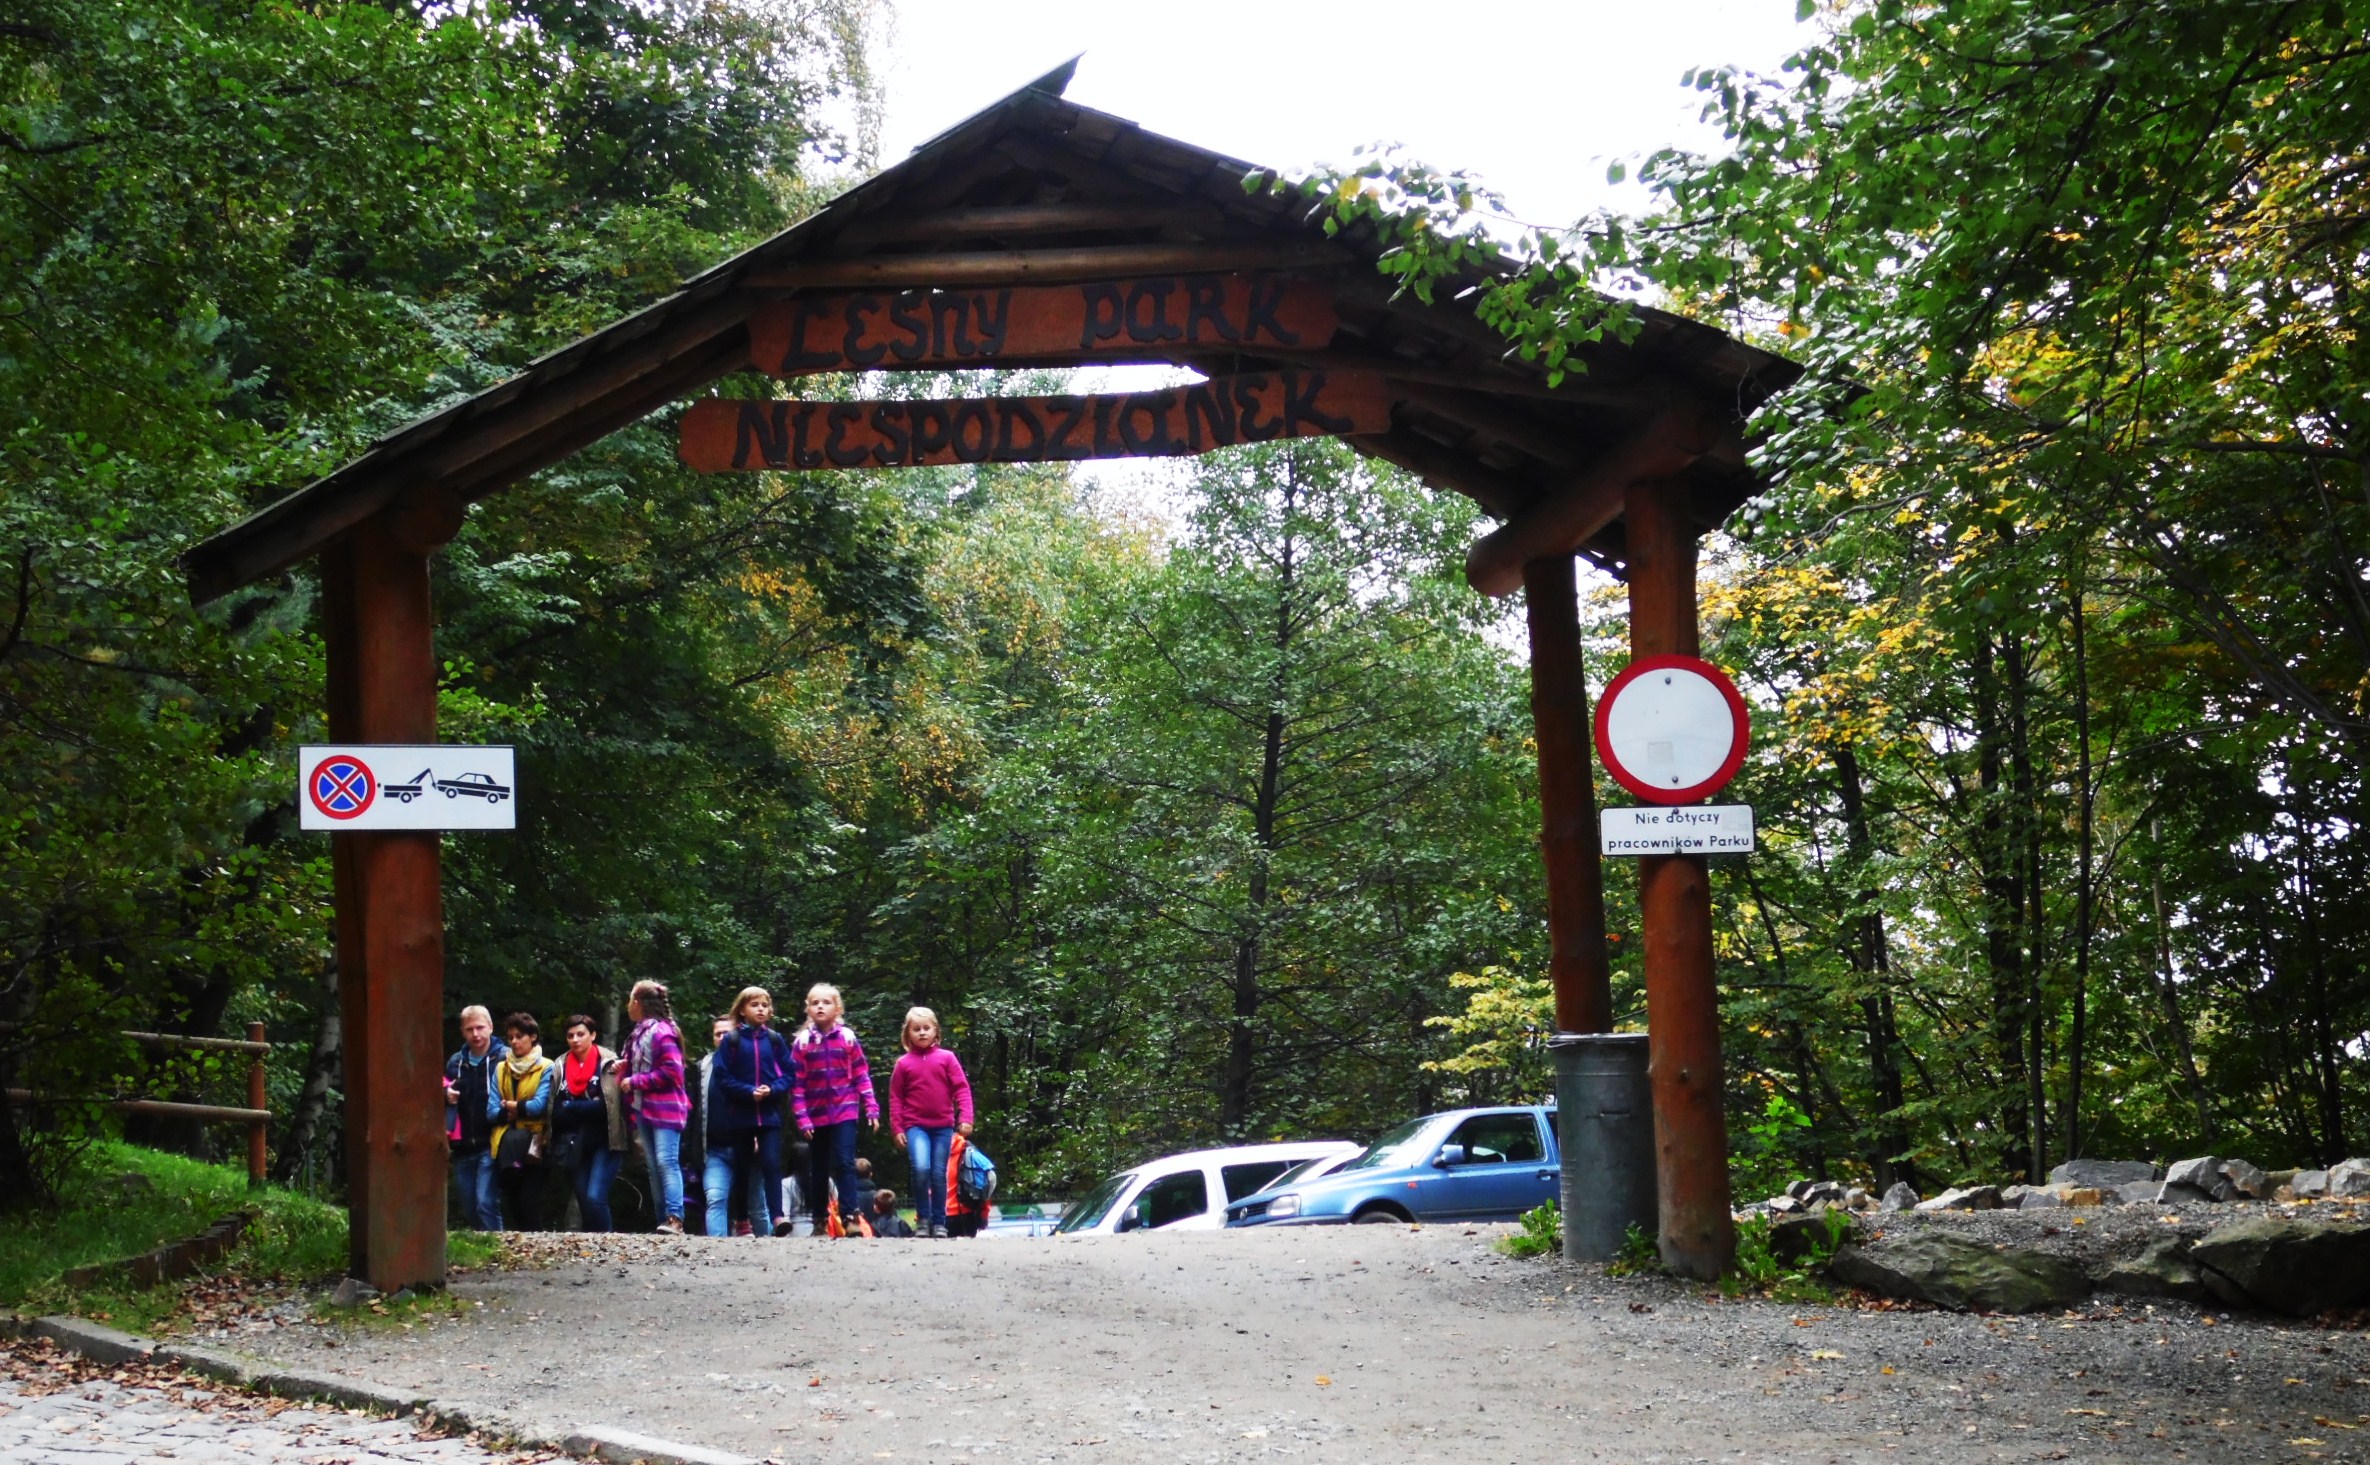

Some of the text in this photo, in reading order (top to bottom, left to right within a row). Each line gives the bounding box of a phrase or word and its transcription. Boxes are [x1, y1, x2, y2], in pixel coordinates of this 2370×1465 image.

[1635, 811, 1720, 825] Nie dotyczy
[1710, 835, 1749, 847] Parku
